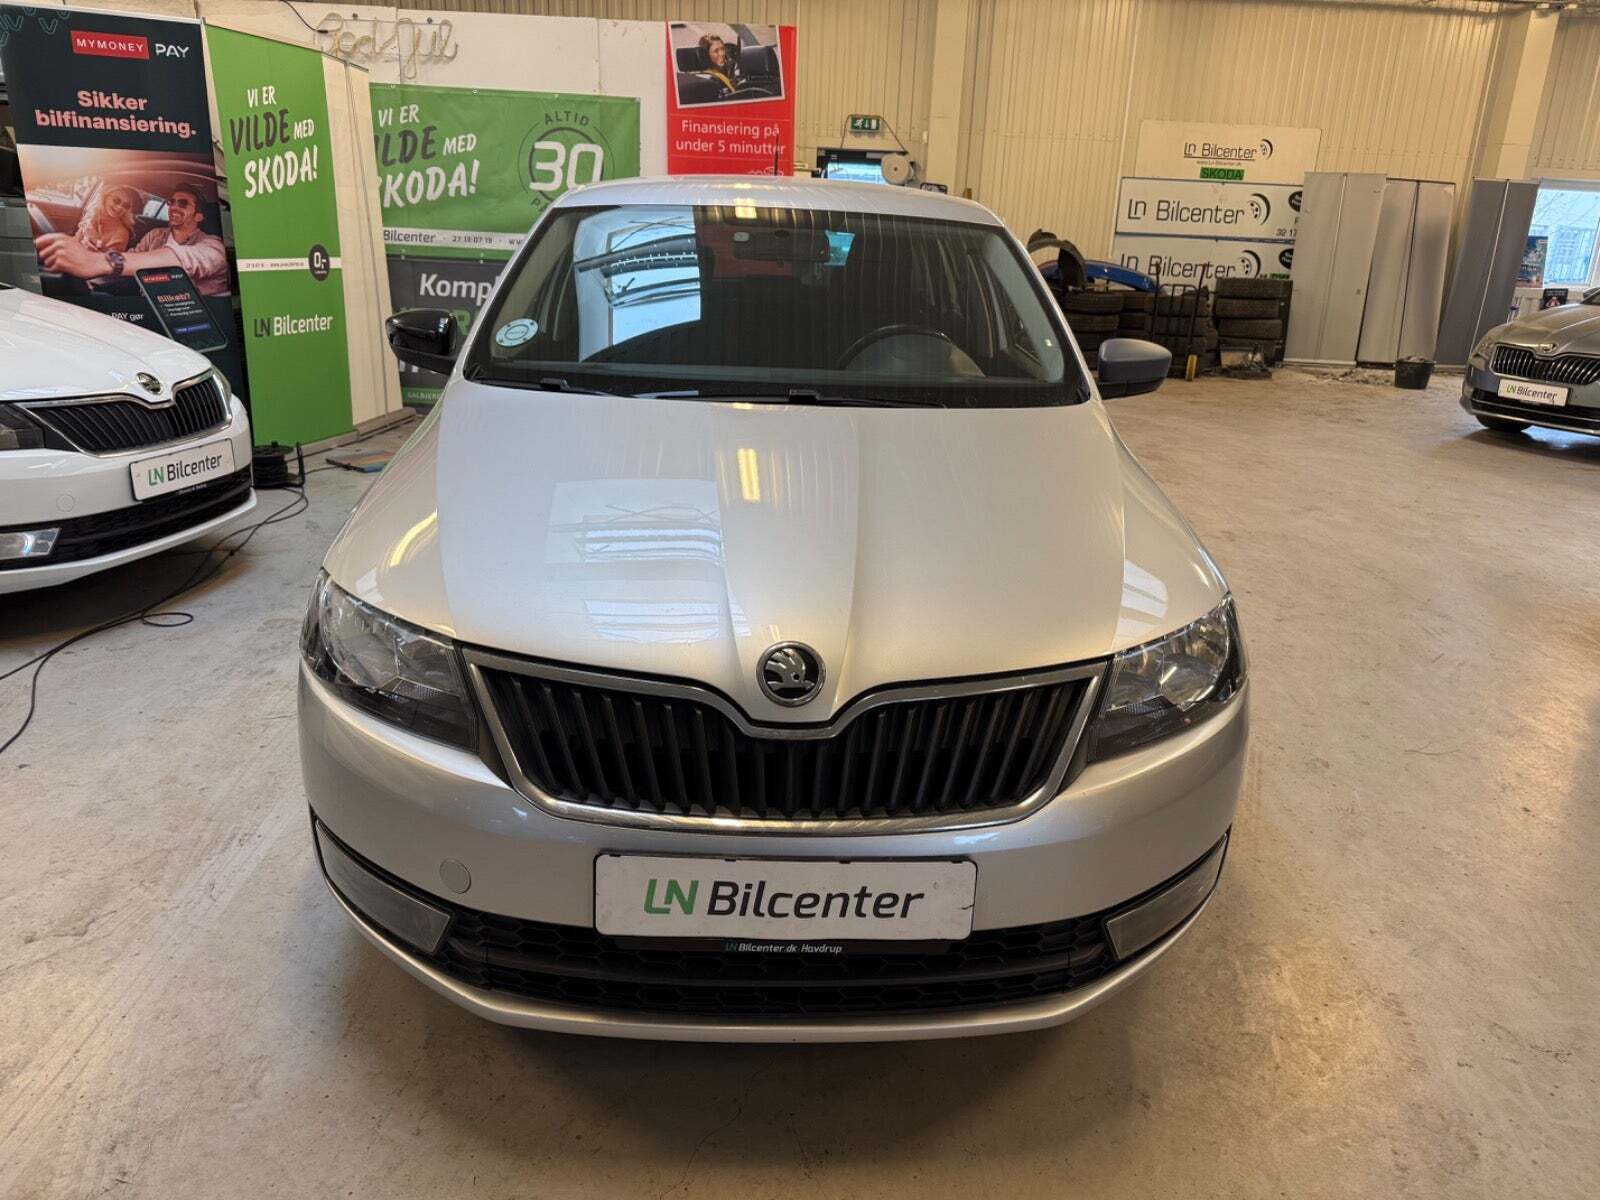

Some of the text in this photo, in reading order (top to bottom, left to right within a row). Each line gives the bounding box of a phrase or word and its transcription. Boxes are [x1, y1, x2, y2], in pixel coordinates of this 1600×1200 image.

[76, 38, 190, 58] MYMONEY PAY
[77, 89, 148, 111] Sikker
[247, 85, 277, 108] VI ER
[35, 109, 197, 139] bilfinansiering.
[378, 104, 420, 128] VI ER
[545, 111, 589, 126] ALTID
[229, 108, 315, 156] VILDE MED
[681, 120, 780, 139] Finansiering på
[443, 133, 477, 156] MED
[676, 139, 786, 155] under 5 minutter
[1201, 142, 1257, 159] Bilcenter
[244, 144, 318, 198] SKODA!
[529, 140, 604, 191] 30
[378, 159, 480, 208] KODA!
[1156, 199, 1245, 225] Bilcenter
[383, 230, 436, 243] Bilcenter
[1148, 255, 1236, 279] Bilcenter
[420, 273, 499, 306] Komp
[254, 314, 333, 338] LN Bilcenter
[1517, 386, 1557, 400] Bilcenter
[148, 454, 222, 486] LN Bilcenter
[643, 879, 925, 919] LN Bilcenter
